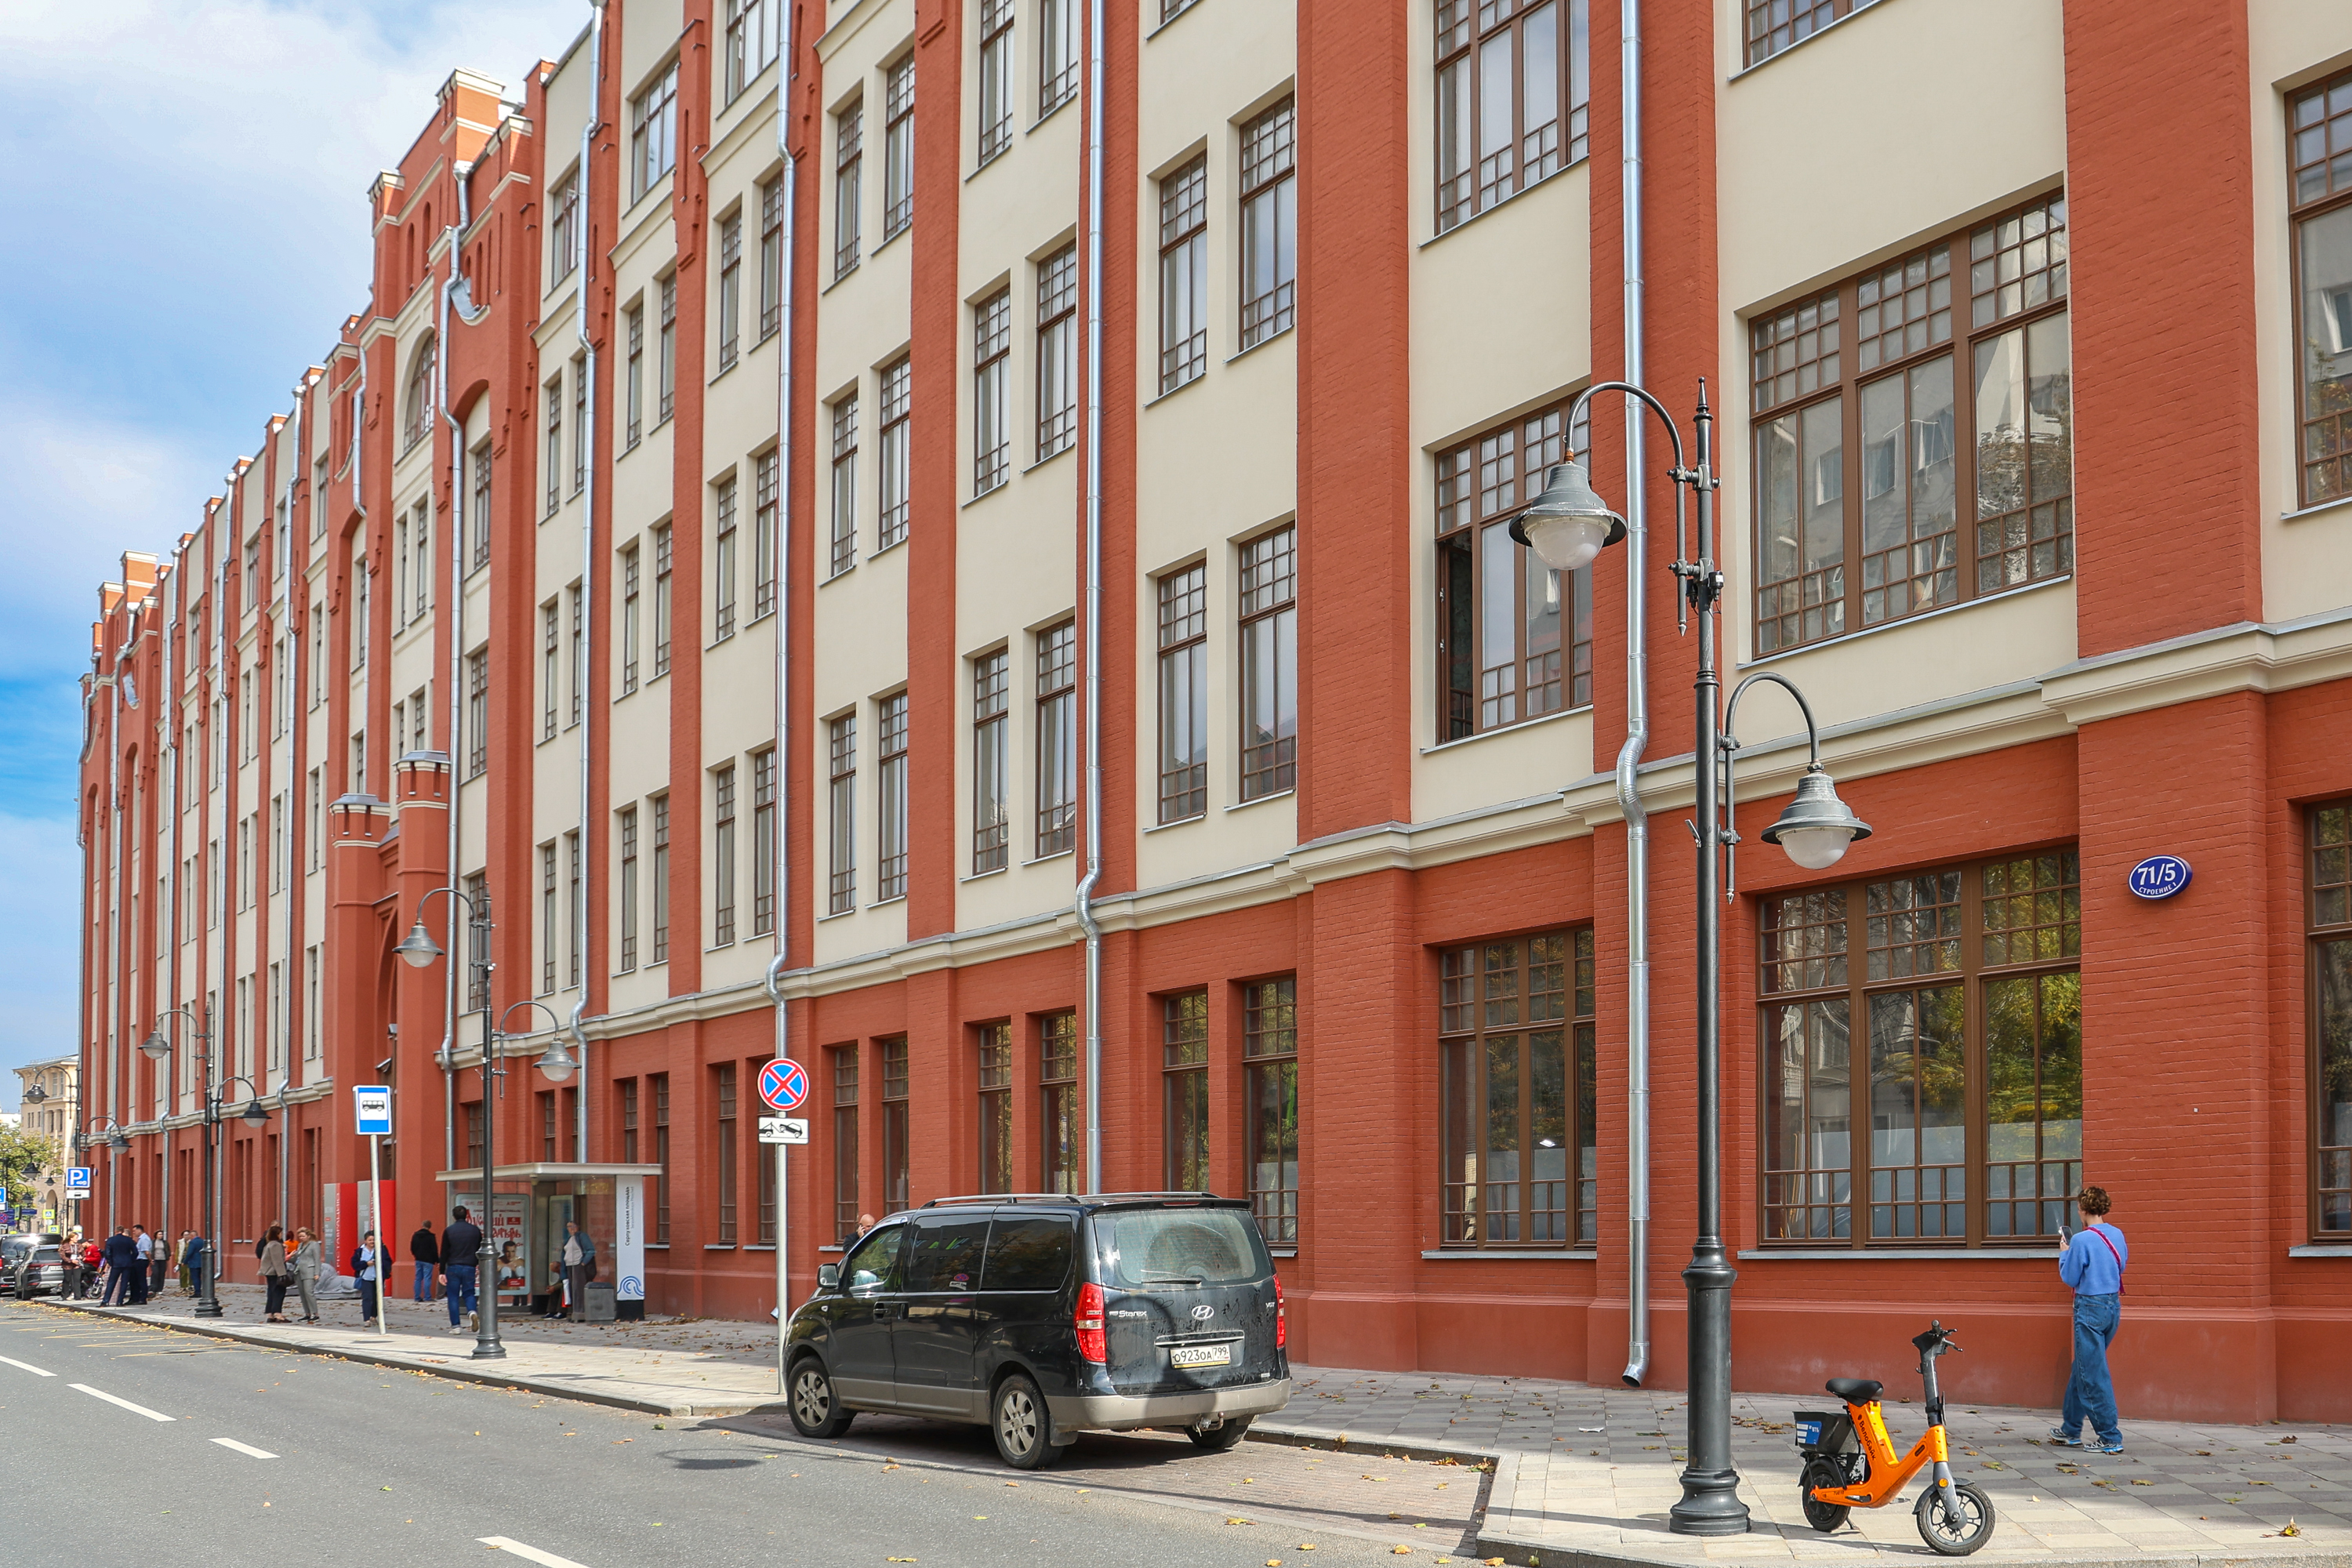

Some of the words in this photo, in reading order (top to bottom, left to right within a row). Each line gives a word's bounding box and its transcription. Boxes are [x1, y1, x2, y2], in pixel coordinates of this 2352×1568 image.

[2138, 863, 2176, 886] 71/5
[2139, 884, 2172, 895] СТРОЕНИЕ
[1174, 1349, 1212, 1363] О923ОА
[1213, 1346, 1227, 1356] 799
[1859, 1421, 1877, 1461] Велобайк
